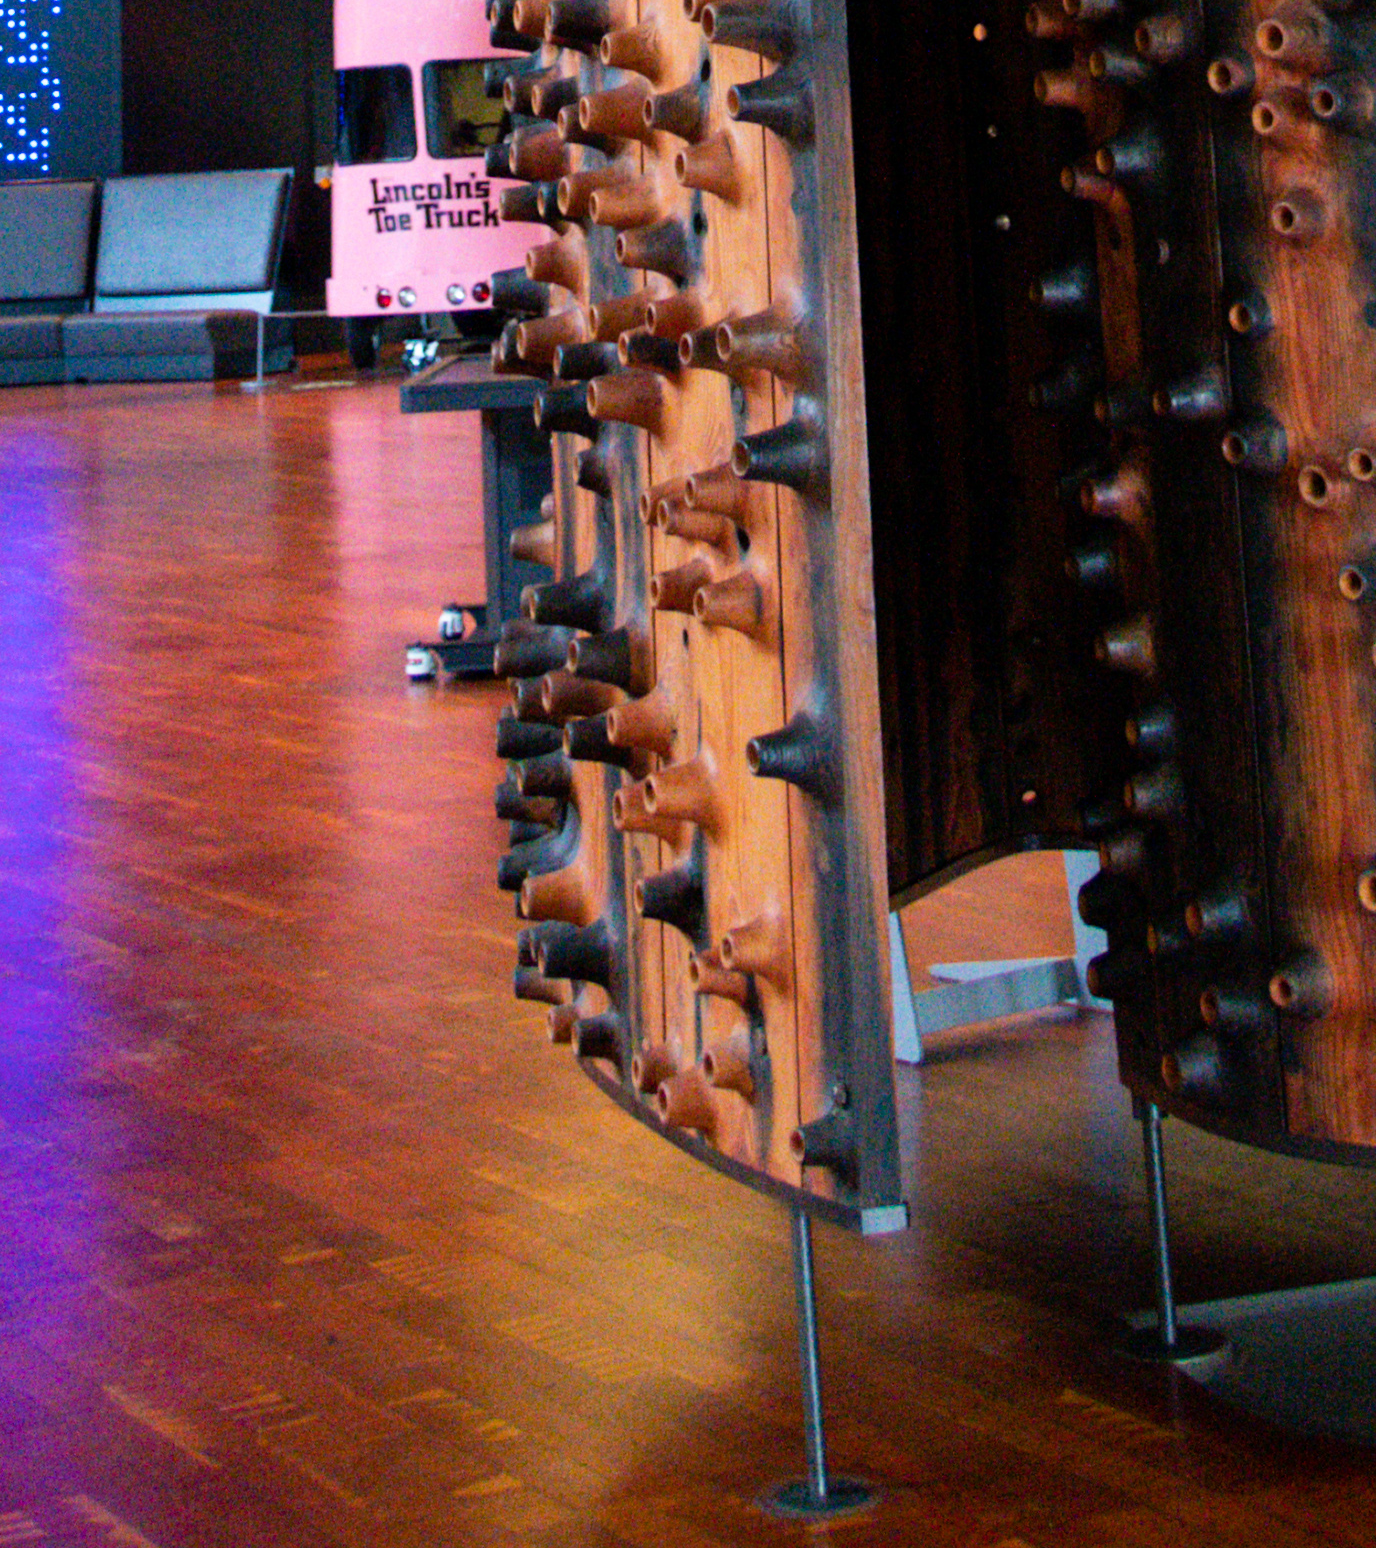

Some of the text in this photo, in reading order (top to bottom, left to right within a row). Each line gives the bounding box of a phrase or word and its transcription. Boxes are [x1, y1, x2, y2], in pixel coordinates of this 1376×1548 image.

[370, 172, 491, 205] Lincoln's
[368, 200, 500, 234] Toe Truck
